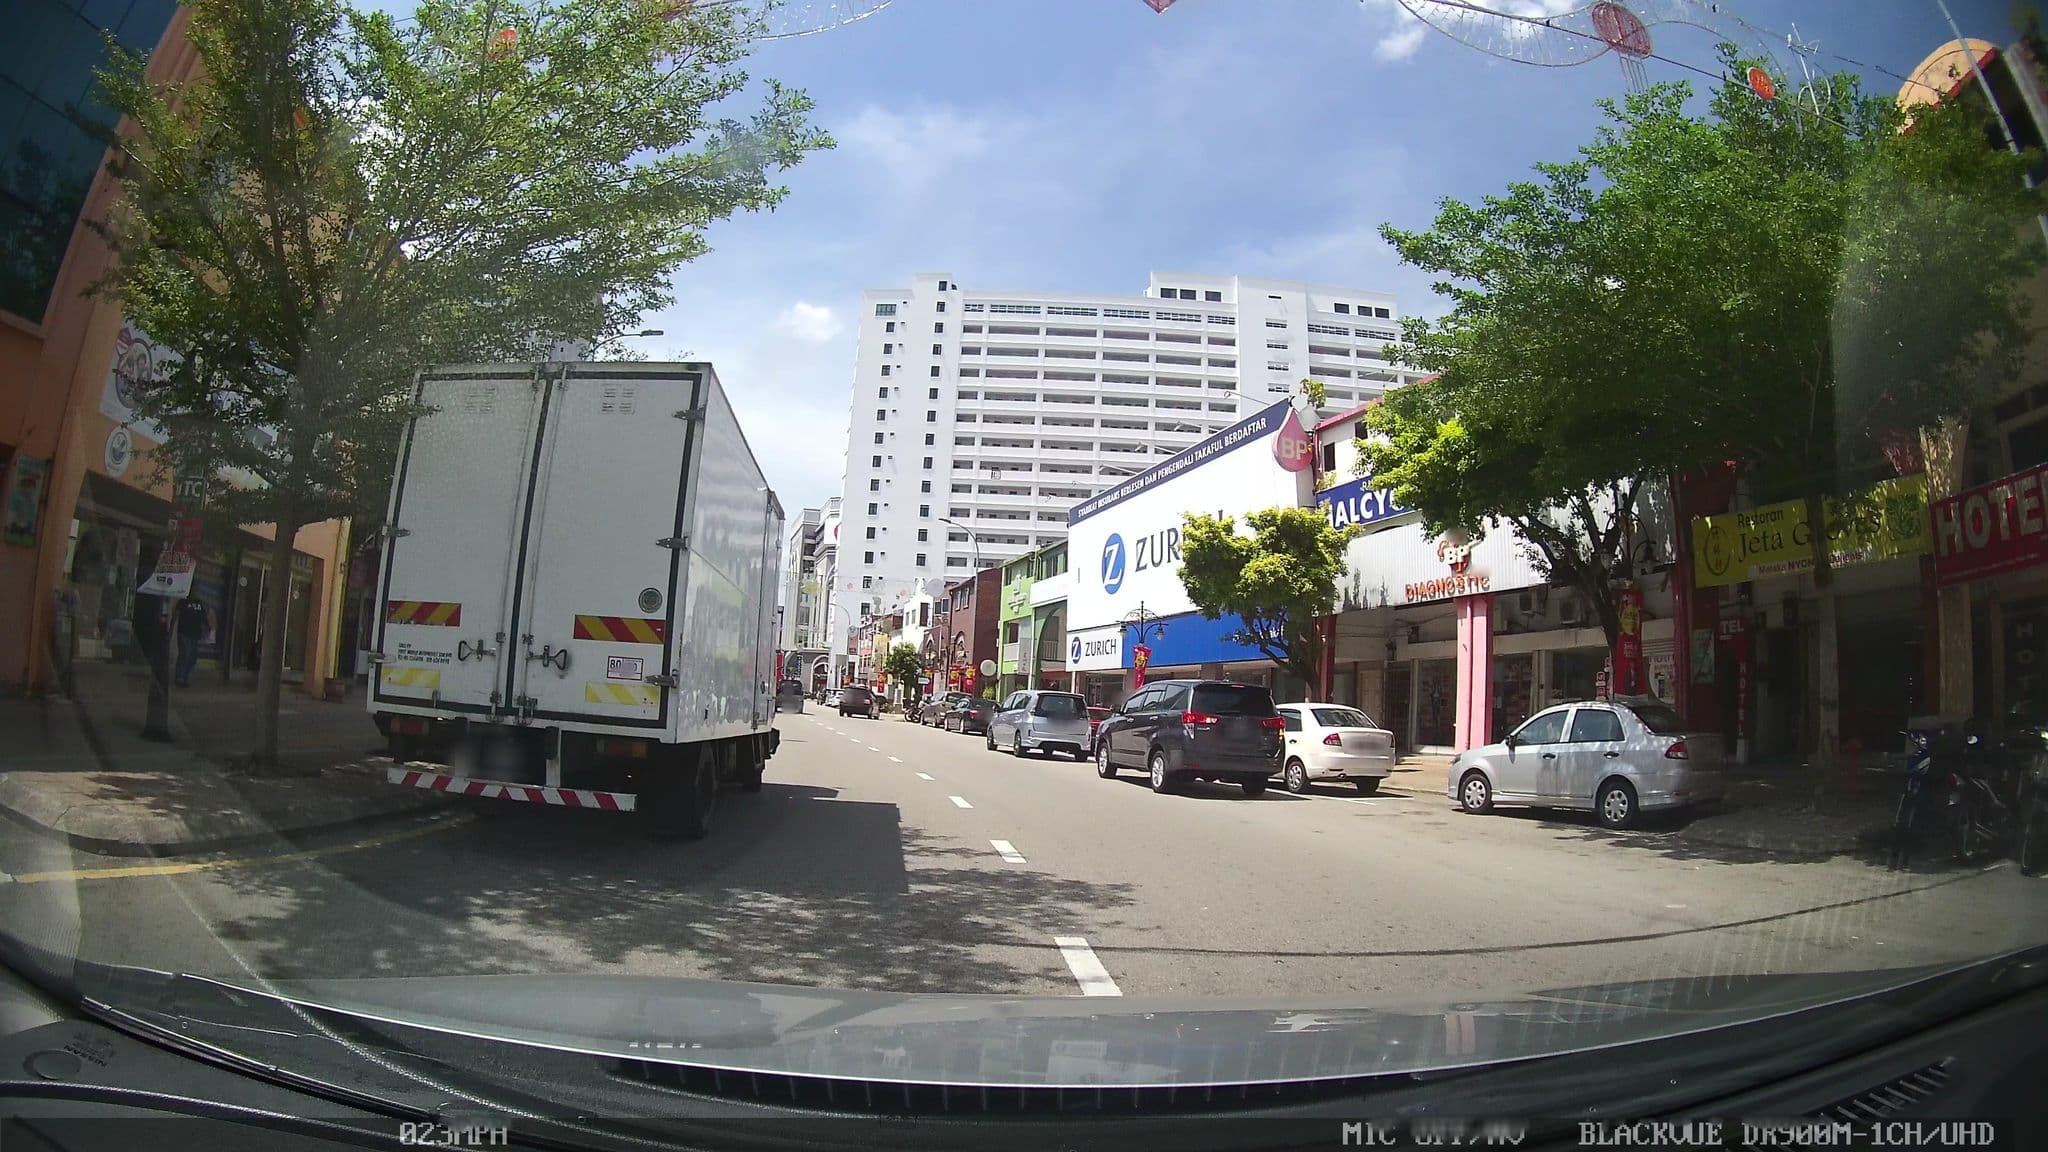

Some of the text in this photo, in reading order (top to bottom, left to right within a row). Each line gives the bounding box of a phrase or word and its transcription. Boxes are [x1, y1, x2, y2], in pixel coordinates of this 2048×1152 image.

[1145, 474, 1157, 487] DAN
[1157, 456, 1194, 480] PENGENDALI
[1194, 442, 1224, 461] TAKAFUL
[1224, 417, 1267, 447] BERDAFTAR
[1282, 438, 1308, 460] BP
[1737, 509, 1784, 526] Restoran
[1135, 527, 1186, 573] ZUR
[1738, 531, 1784, 562] Jeta
[1788, 557, 1816, 570] NYON
[1405, 575, 1490, 602] DIAGNOSTIC
[1085, 639, 1117, 657] ZURICH
